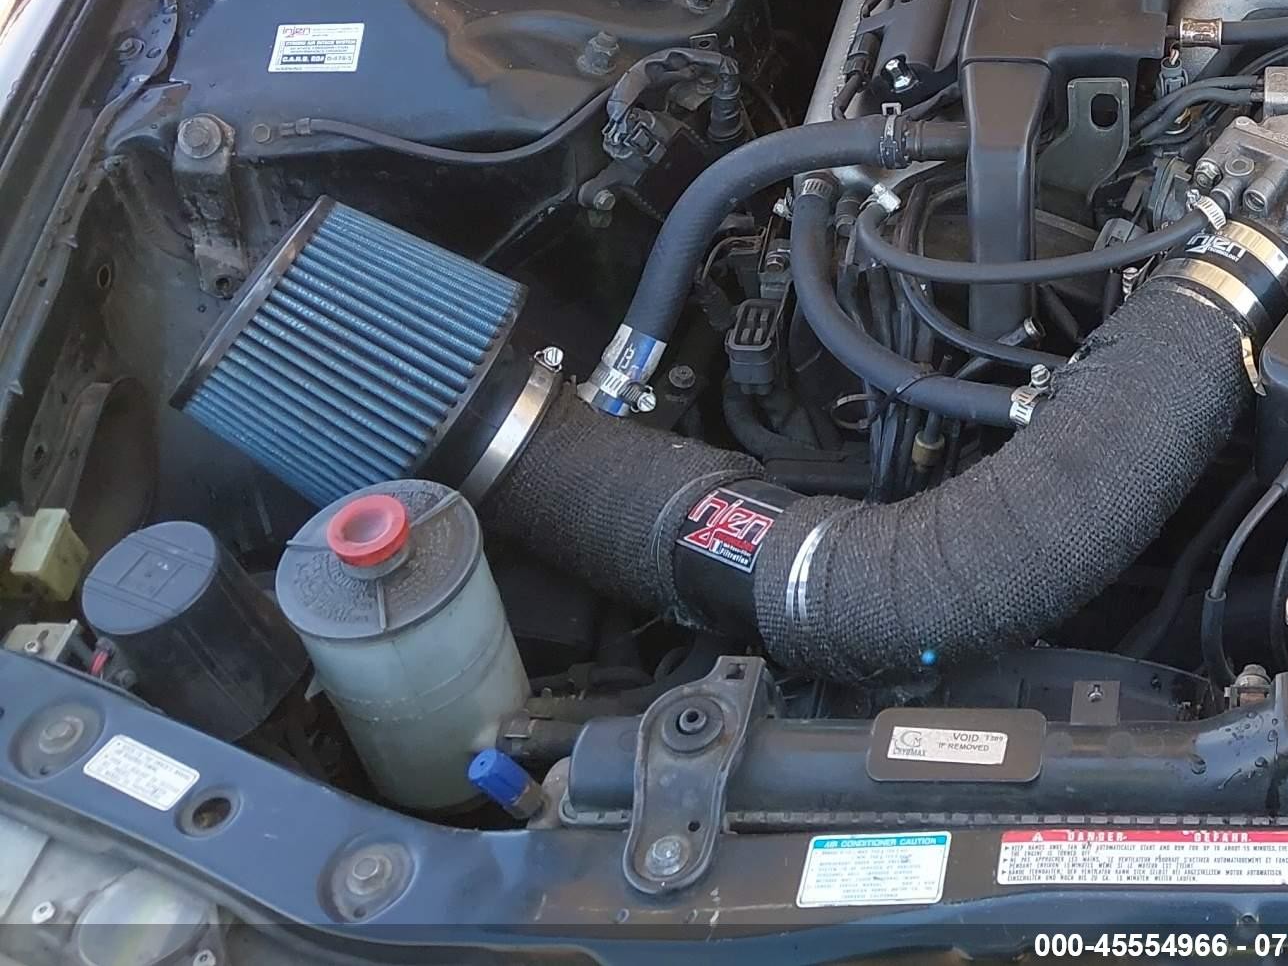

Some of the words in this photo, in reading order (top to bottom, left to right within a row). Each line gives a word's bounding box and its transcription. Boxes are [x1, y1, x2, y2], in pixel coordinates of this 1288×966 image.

[720, 549, 749, 565] Filtration
[953, 733, 979, 742] VOID
[947, 743, 989, 752] REMOVED
[1067, 832, 1124, 841] DANGER
[1194, 832, 1249, 842] GEFAHR
[840, 839, 896, 848] CONDITIONER
[900, 838, 937, 846] CAUTION
